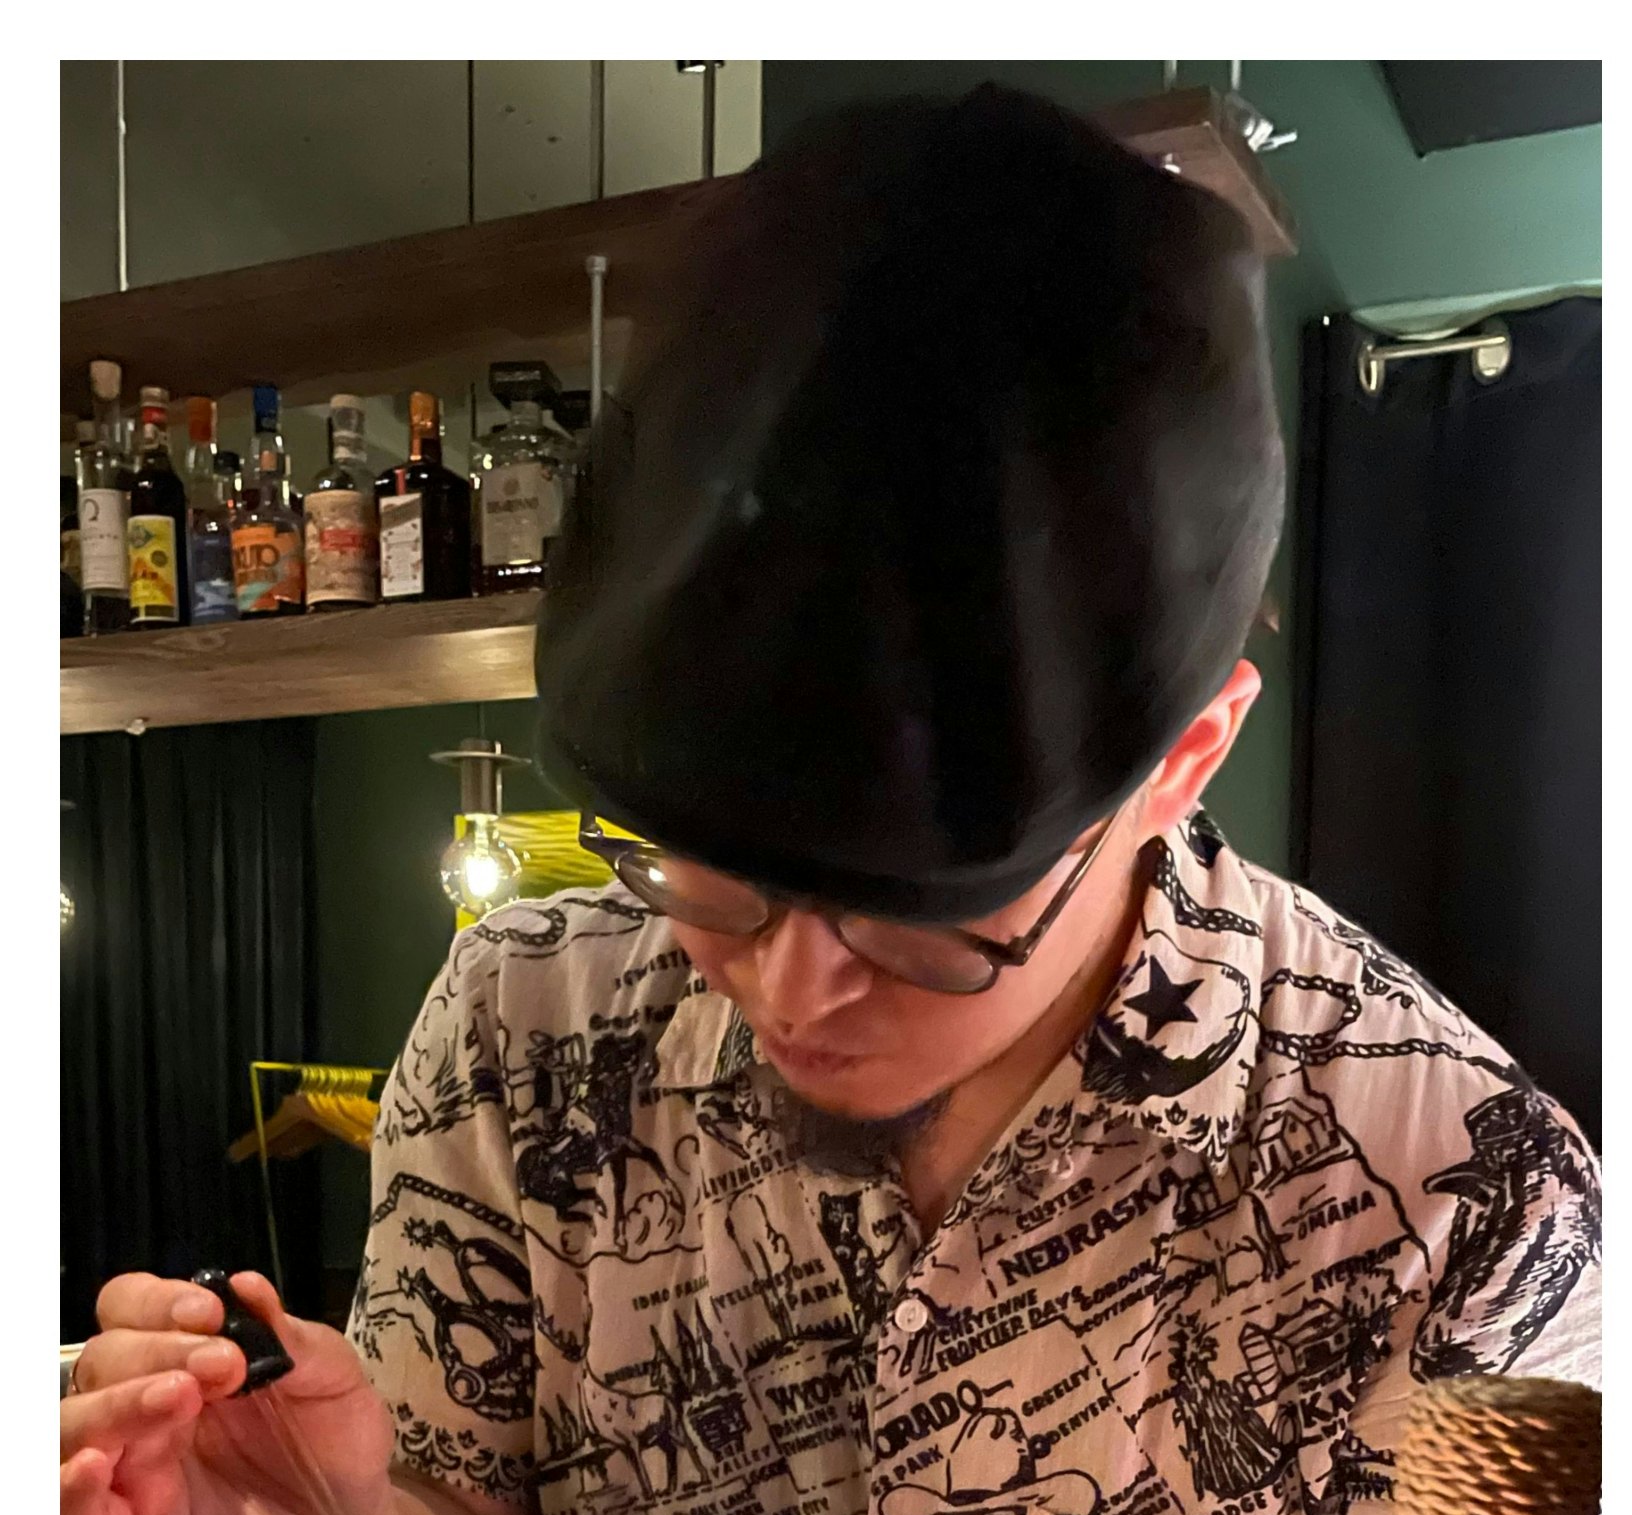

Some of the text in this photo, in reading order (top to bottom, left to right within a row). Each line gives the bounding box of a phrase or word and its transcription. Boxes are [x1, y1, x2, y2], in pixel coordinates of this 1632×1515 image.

[997, 1166, 1182, 1287] NEBRASKA
[1015, 1176, 1095, 1231] CUSTER
[786, 1278, 843, 1311] PARK
[938, 1287, 1038, 1346] CHEYENNE
[936, 1315, 1025, 1372] FRONTIER
[1021, 1363, 1091, 1418] GREELEY
[711, 1445, 771, 1479] VALLEY
[893, 1443, 945, 1482] PARK
